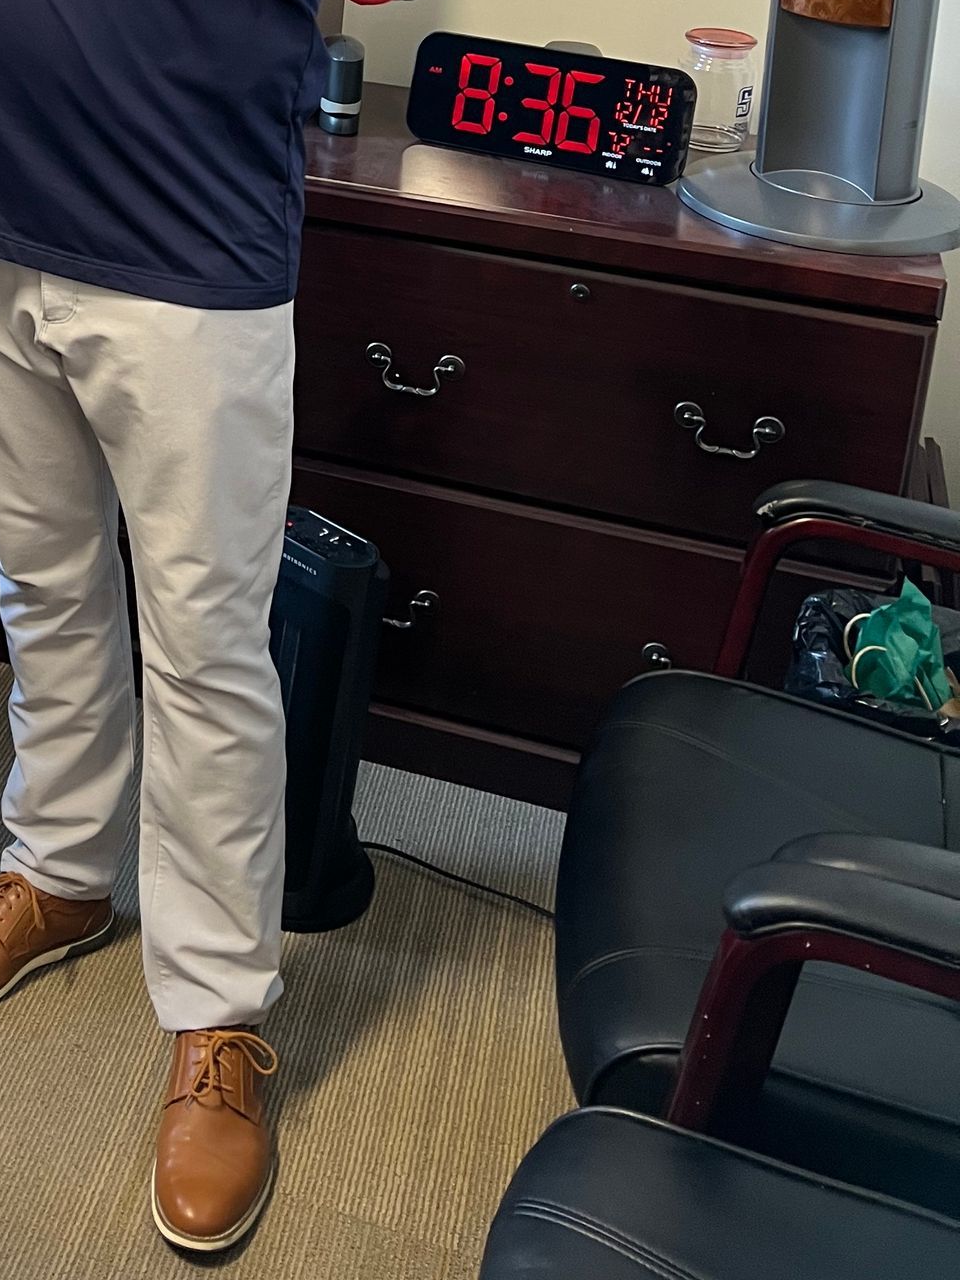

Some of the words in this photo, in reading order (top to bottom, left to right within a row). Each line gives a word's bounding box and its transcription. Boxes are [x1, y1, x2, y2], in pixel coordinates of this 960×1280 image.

[428, 66, 442, 74] AM
[624, 78, 672, 106] THU
[451, 52, 606, 155] 8:36
[615, 102, 668, 130] 12/12
[623, 122, 643, 131] TODAY'S
[524, 146, 552, 158] SHARP
[602, 152, 622, 160] INDOOR
[636, 158, 662, 166] OUTDOOR
